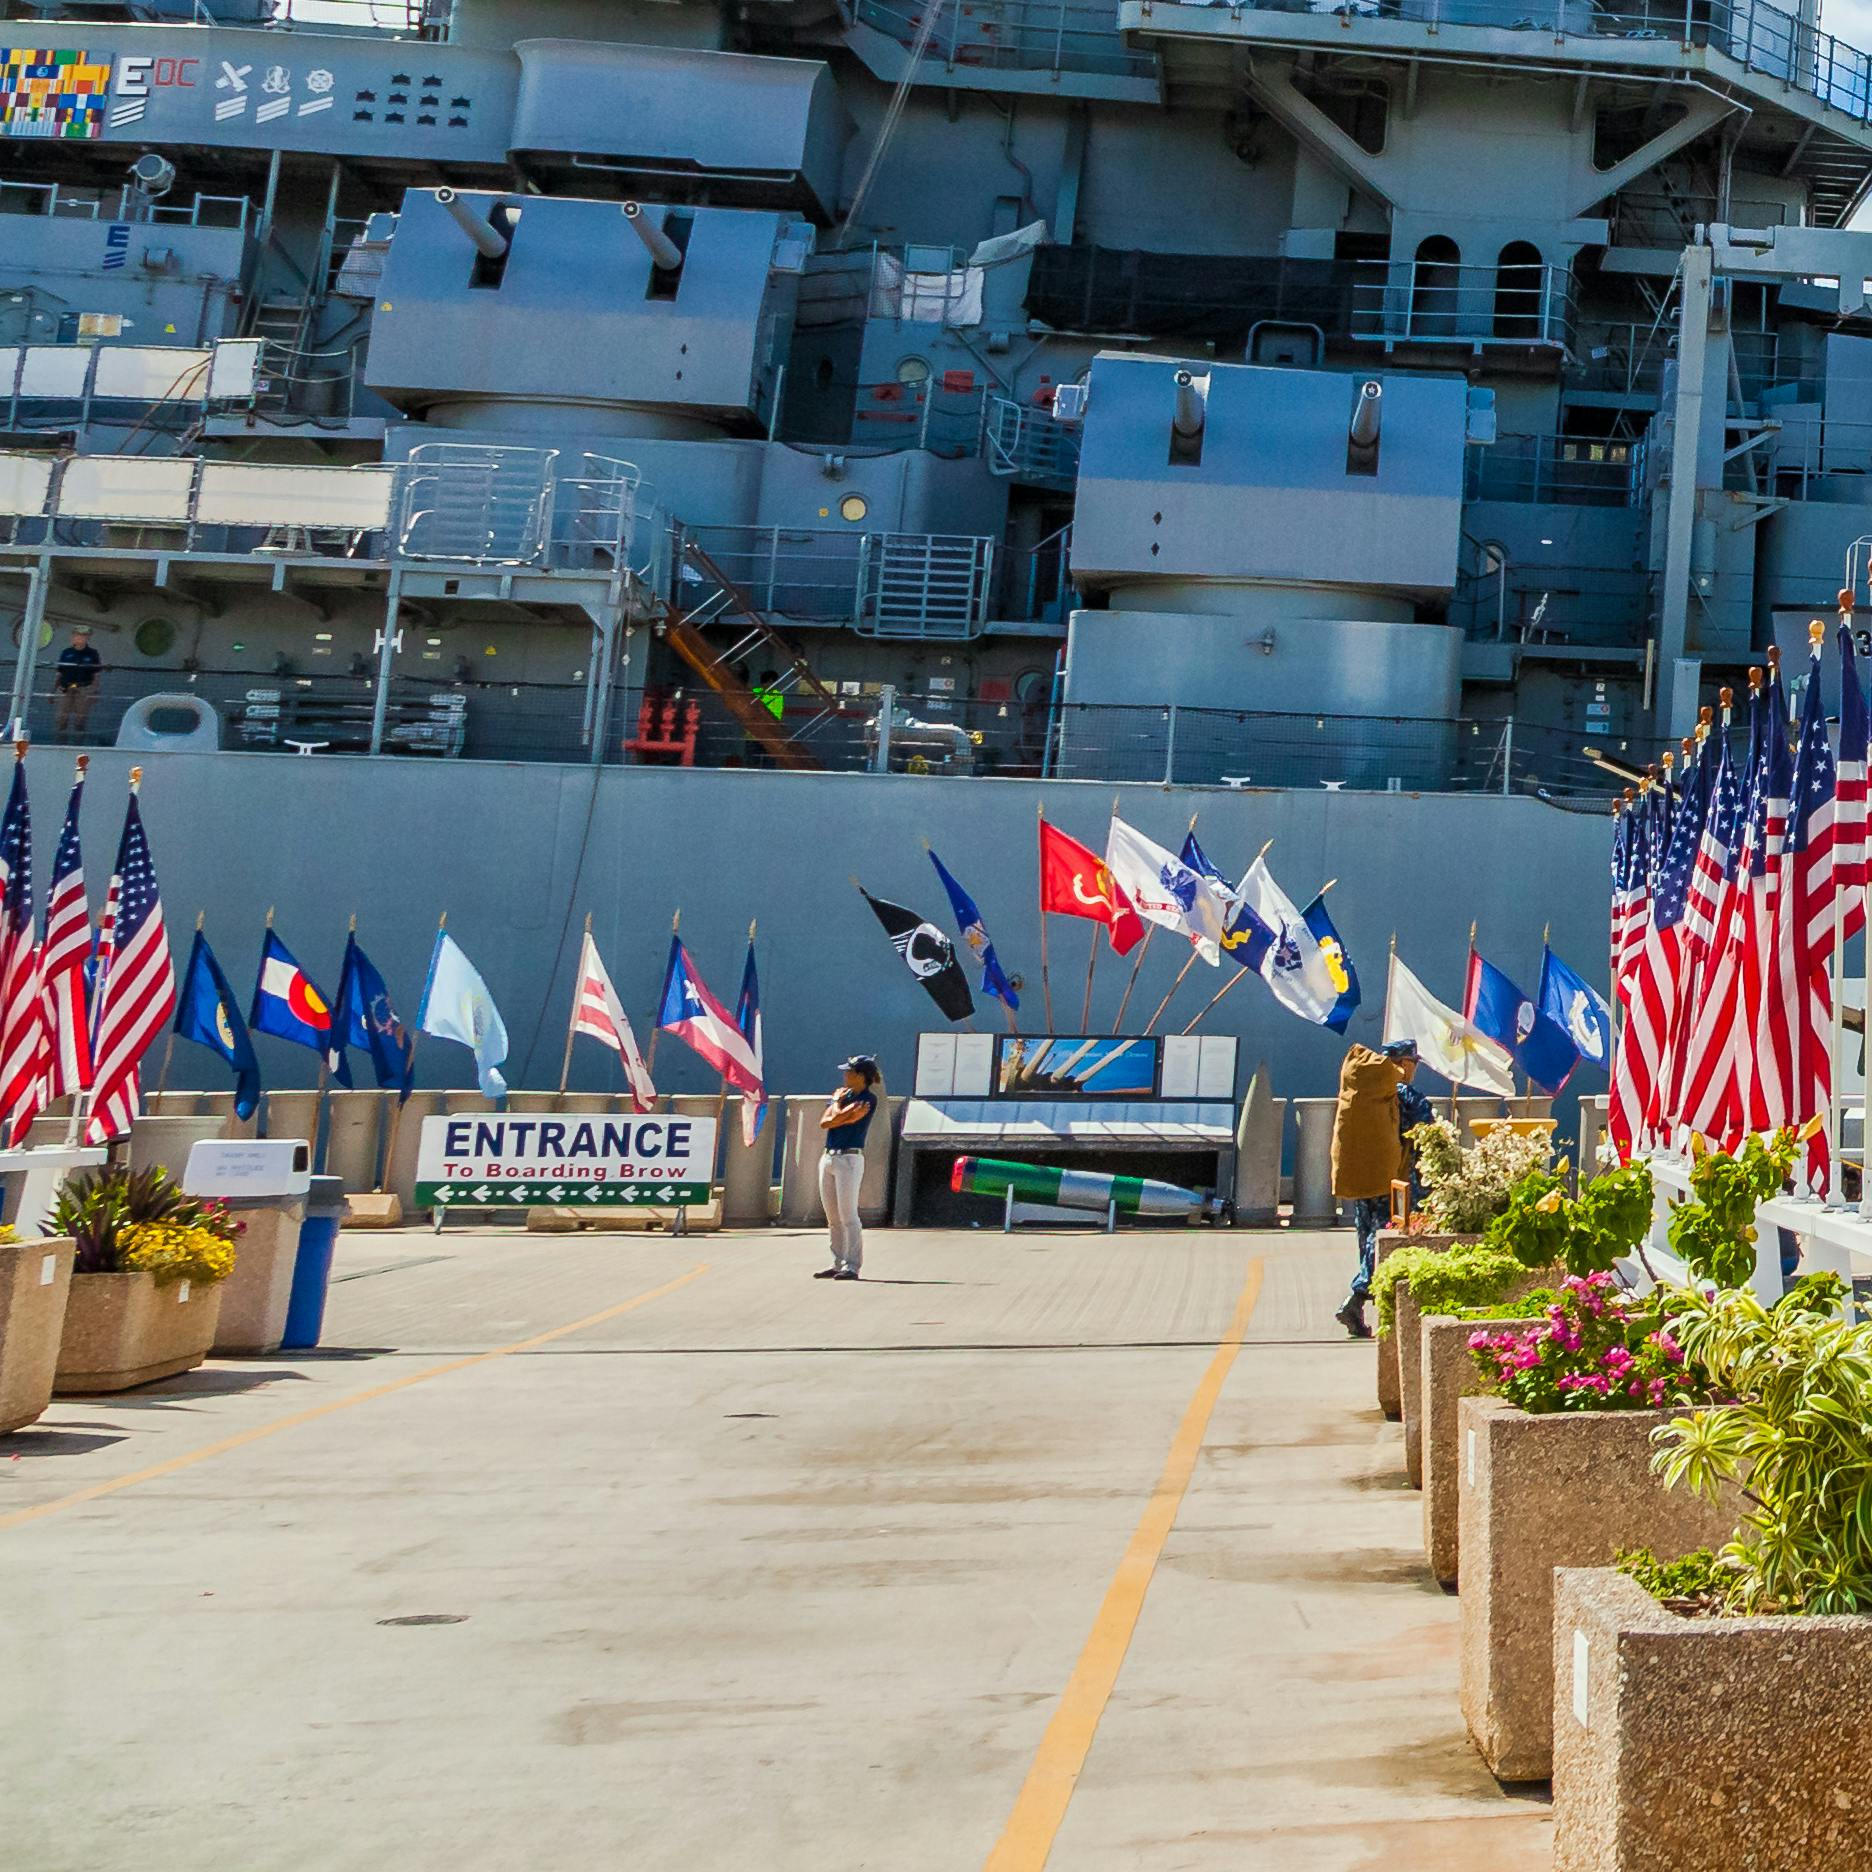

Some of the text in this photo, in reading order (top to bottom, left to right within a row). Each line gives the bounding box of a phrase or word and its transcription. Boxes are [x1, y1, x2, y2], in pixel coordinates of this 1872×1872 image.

[116, 57, 153, 96] E
[106, 225, 130, 248] E
[444, 1121, 692, 1158] ENTRANCE
[443, 1163, 687, 1181] To Boarding Brow
